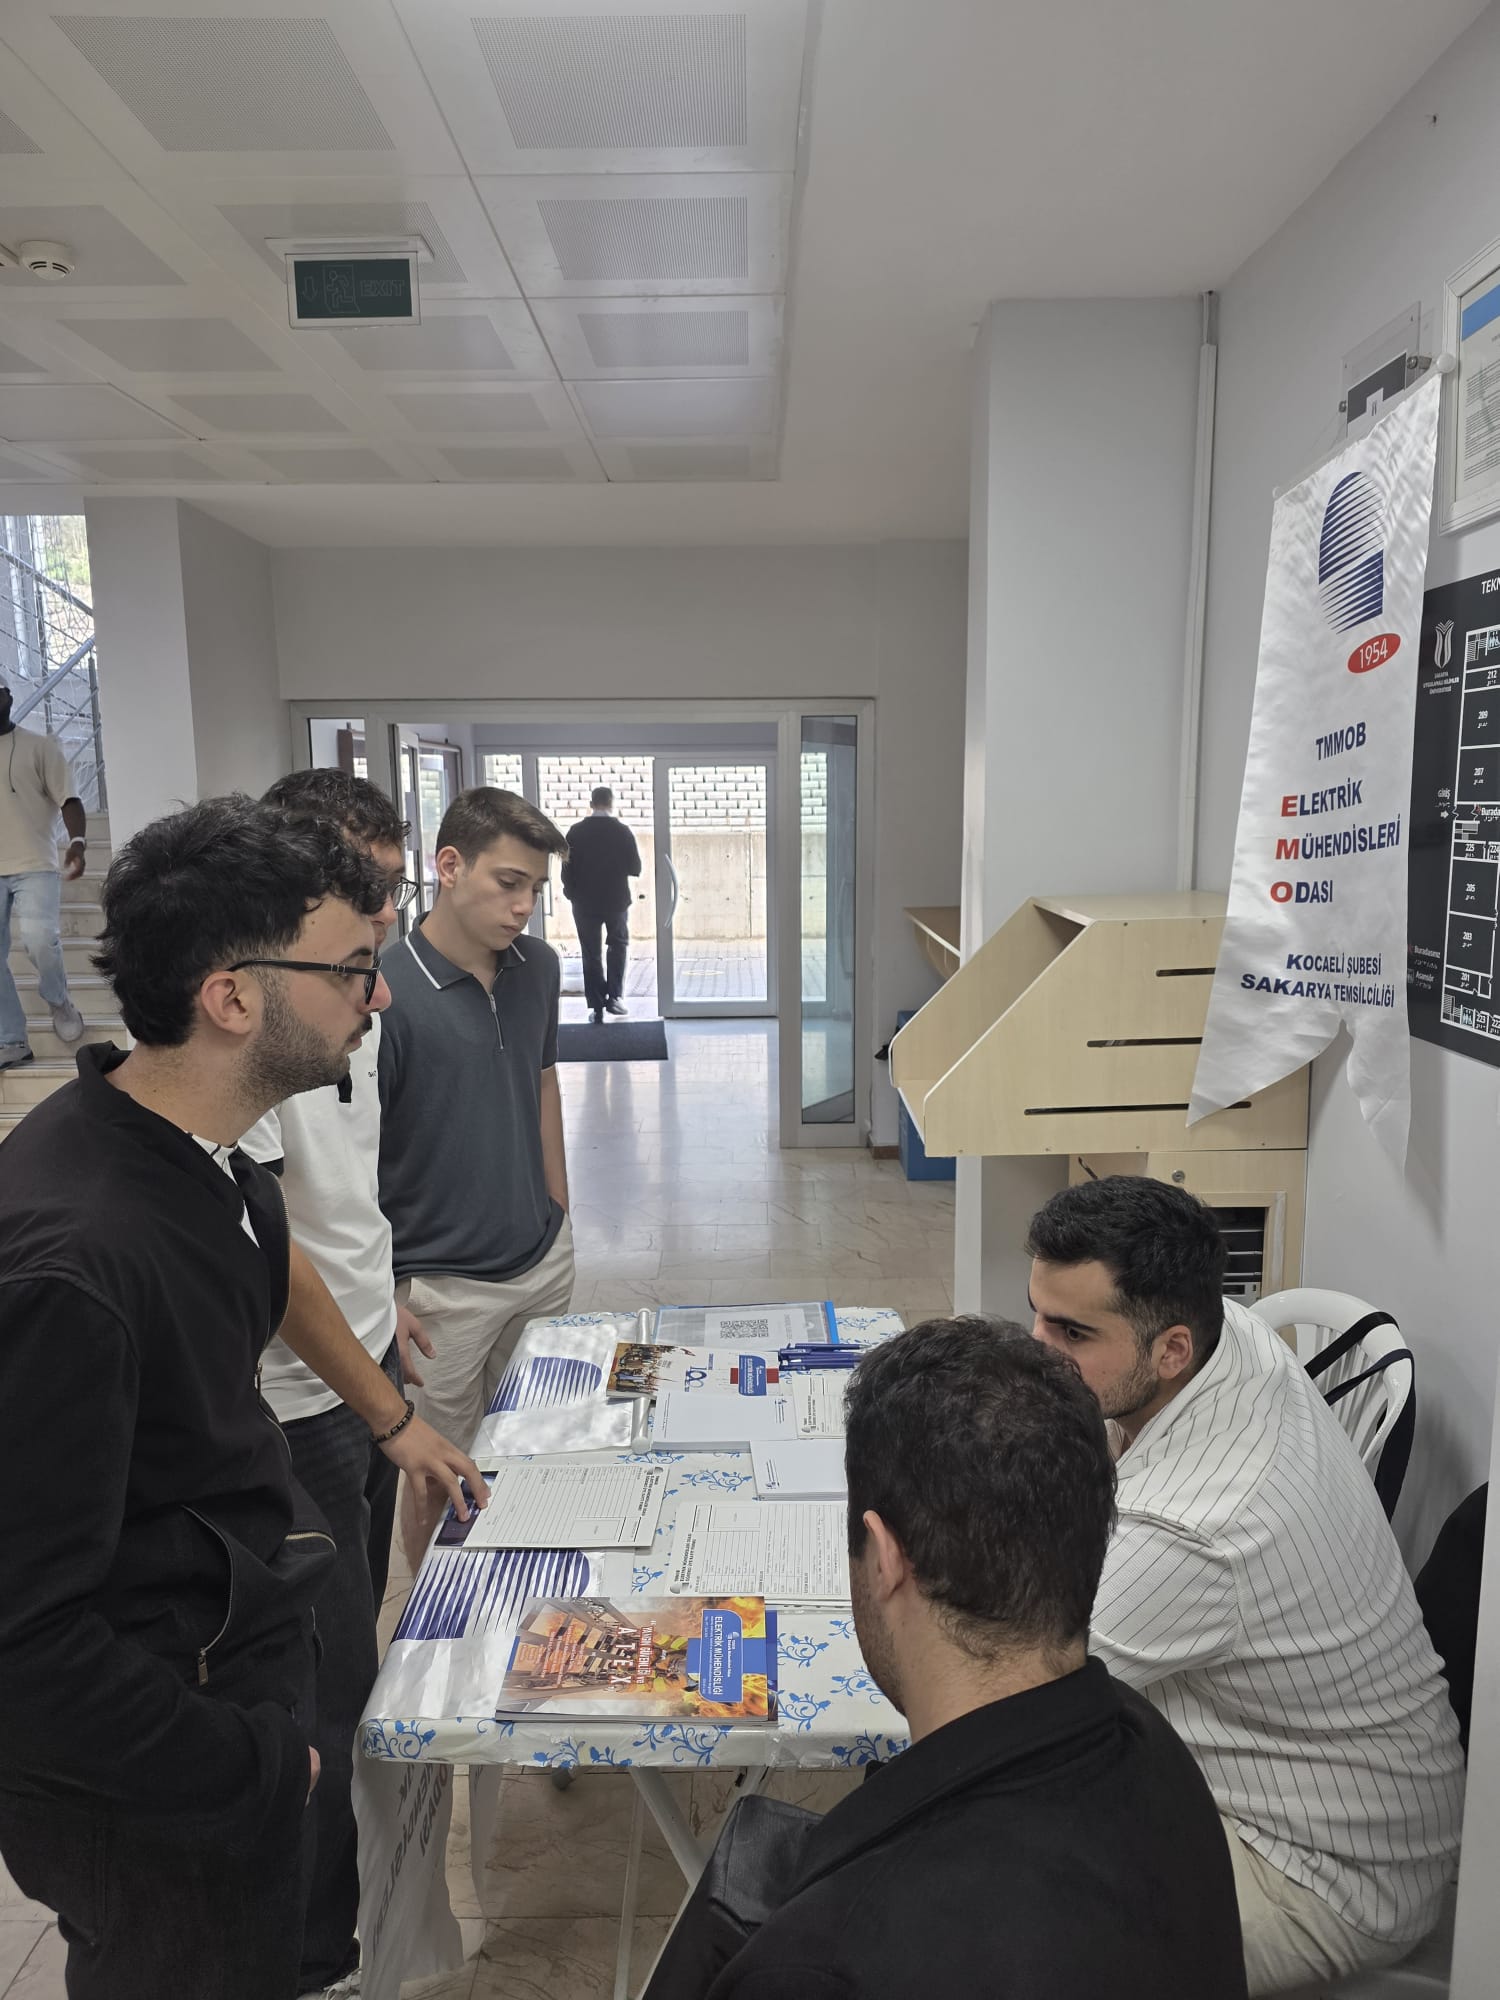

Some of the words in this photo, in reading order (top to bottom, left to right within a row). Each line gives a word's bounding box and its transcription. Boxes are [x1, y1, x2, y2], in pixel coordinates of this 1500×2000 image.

[360, 279, 404, 297] EXIT
[1359, 641, 1389, 669] 1954
[1487, 670, 1497, 680] 212
[1315, 721, 1366, 761] TMMOB
[1281, 777, 1364, 817] ELEKTRİK
[1275, 813, 1401, 861] MÜHENDİSLERİ
[1270, 879, 1333, 904] ODASI
[1286, 952, 1345, 976] KOCAELİ
[1346, 953, 1382, 979] ŞUBESİ
[1240, 973, 1332, 1001] SAKARYA
[1334, 982, 1395, 1008] TEMSİLCİLİĞİ
[714, 1616, 724, 1647] ELEKTRİK
[712, 1647, 724, 1695] MÜHENDİSLİĞİ
